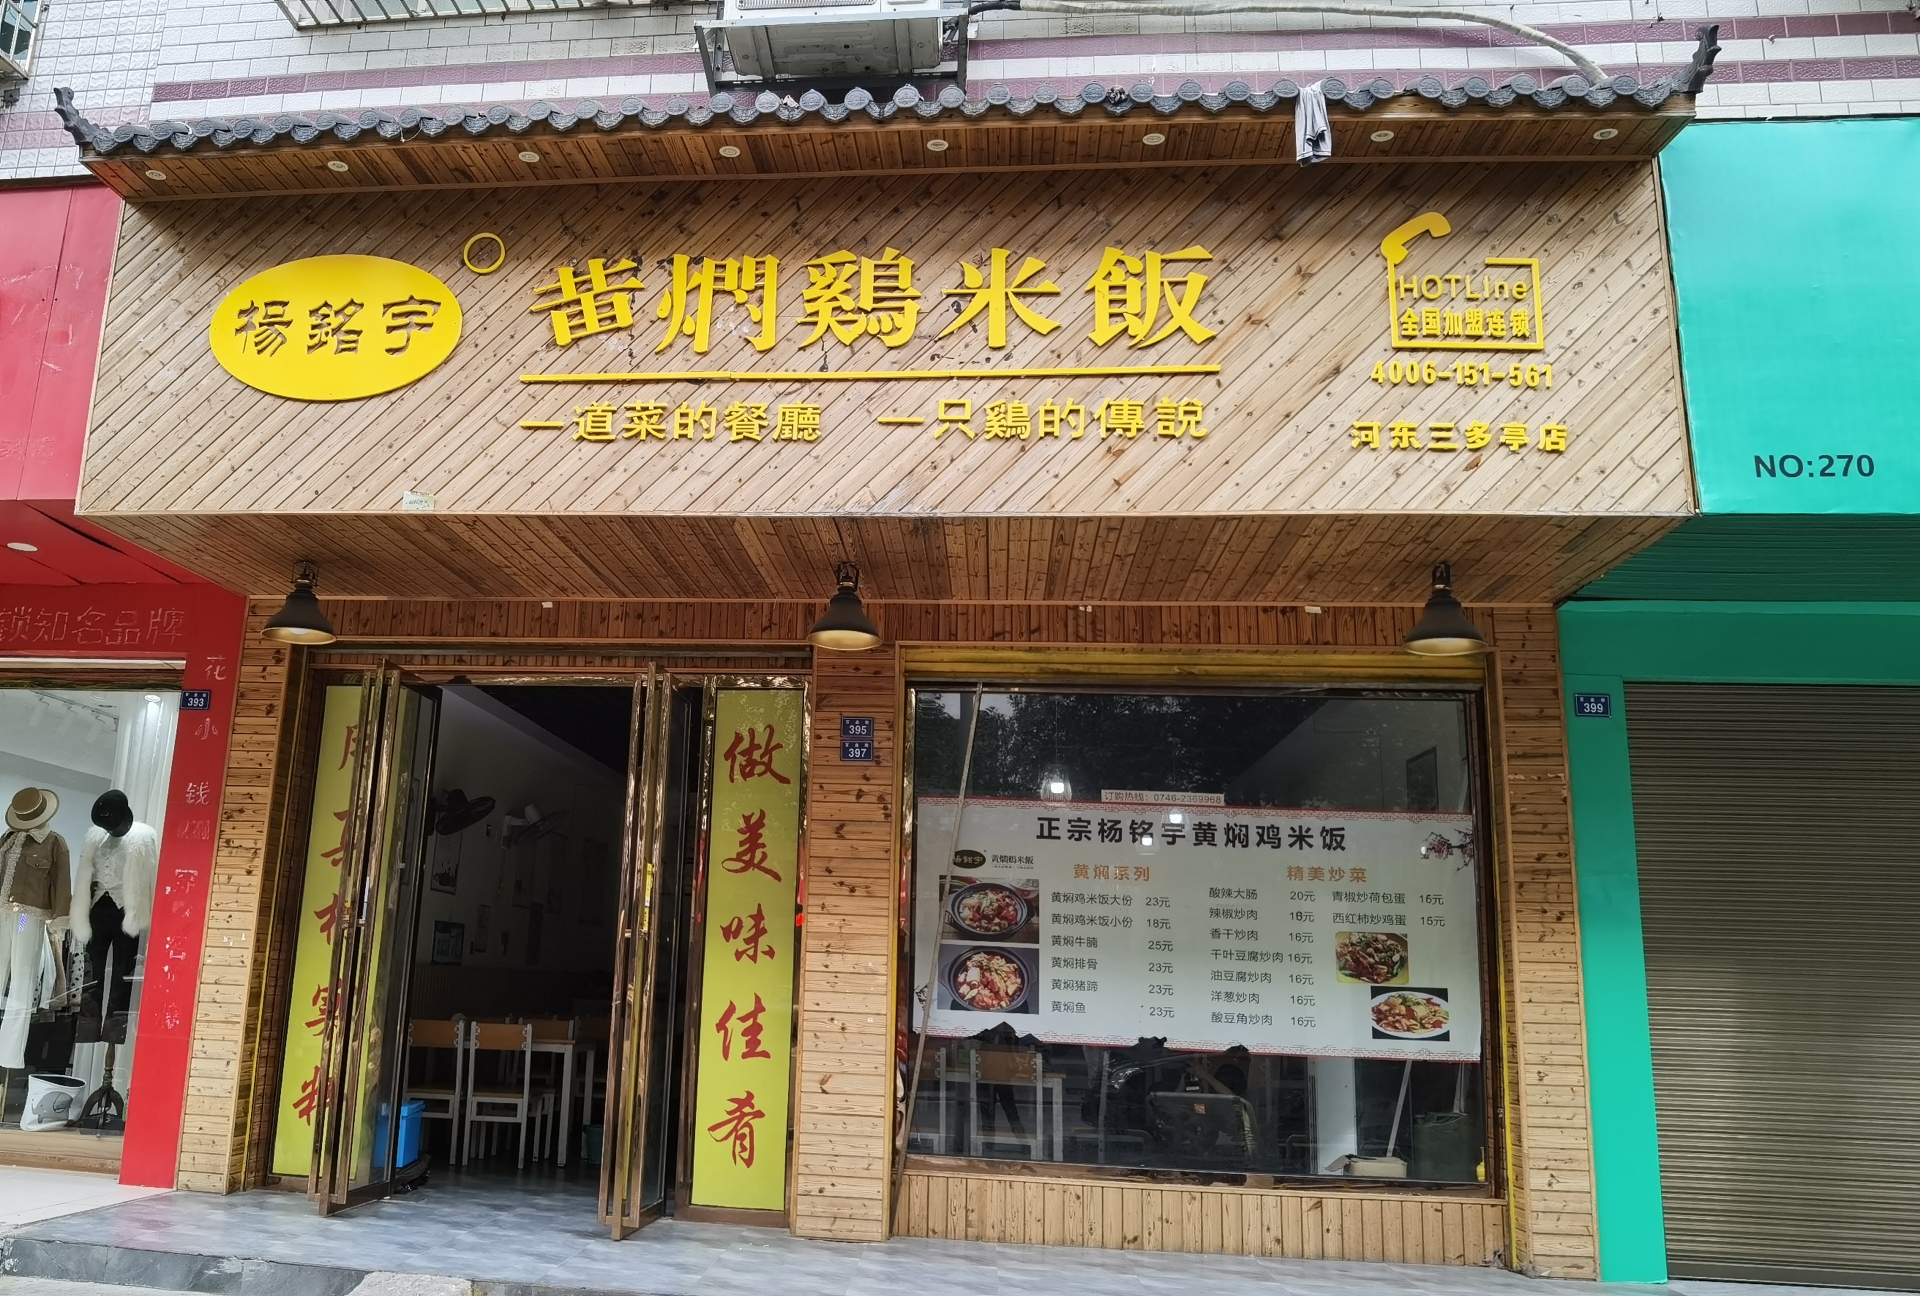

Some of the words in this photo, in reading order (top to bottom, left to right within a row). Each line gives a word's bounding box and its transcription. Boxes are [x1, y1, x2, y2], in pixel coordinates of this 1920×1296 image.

[234, 294, 442, 358] 楊銘宇
[1400, 307, 1530, 338] 全国加盟连锁
[1371, 361, 1552, 388] 4006-151-561
[1350, 420, 1568, 452] 河东三多亭店
[1754, 454, 1875, 478] NO:270
[188, 697, 204, 707] 393
[1584, 702, 1604, 713] 399
[849, 725, 867, 735] 395
[848, 748, 867, 758] 397
[1036, 817, 1347, 851] 正宗杨铭宇黄焖鸡米饭
[1073, 863, 1150, 882] 黄焖系列
[1286, 865, 1367, 883] 精美炒菜
[1051, 891, 1133, 907] 黄焖鸡米饭大份
[1145, 896, 1171, 908] 23元
[1209, 887, 1258, 900] 酸辣大肠
[1289, 890, 1316, 902] 20元
[1332, 891, 1406, 904] 青椒炒荷包蛋
[1051, 913, 1133, 929] 黄焖鸡米饭小份
[1146, 918, 1171, 930] 18元
[1209, 907, 1258, 920] 辣椒炒肉
[1332, 912, 1407, 926] 西红柿炒鸡蛋
[707, 723, 791, 1169] 做美味佳肴
[1051, 935, 1098, 949] 黄焖牛腩
[1148, 940, 1174, 952] 25元
[1288, 932, 1314, 943] 16元
[1051, 956, 1098, 970] 黄焖排骨
[1148, 962, 1174, 974] 23元
[1287, 952, 1313, 964] 16元
[1210, 970, 1272, 984] 油豆腐炒肉
[1288, 973, 1314, 985] 16元
[1051, 978, 1098, 992] 黄焖猪蹄
[1148, 984, 1174, 996] 23元
[1210, 990, 1260, 1004] 洋葱炒肉
[1290, 995, 1316, 1007] 16元
[1051, 1000, 1086, 1013] 黄焖鱼
[1149, 1006, 1175, 1018] 23元
[1211, 1011, 1273, 1026] 酸豆角炒肉
[1290, 1016, 1316, 1028] 16元
